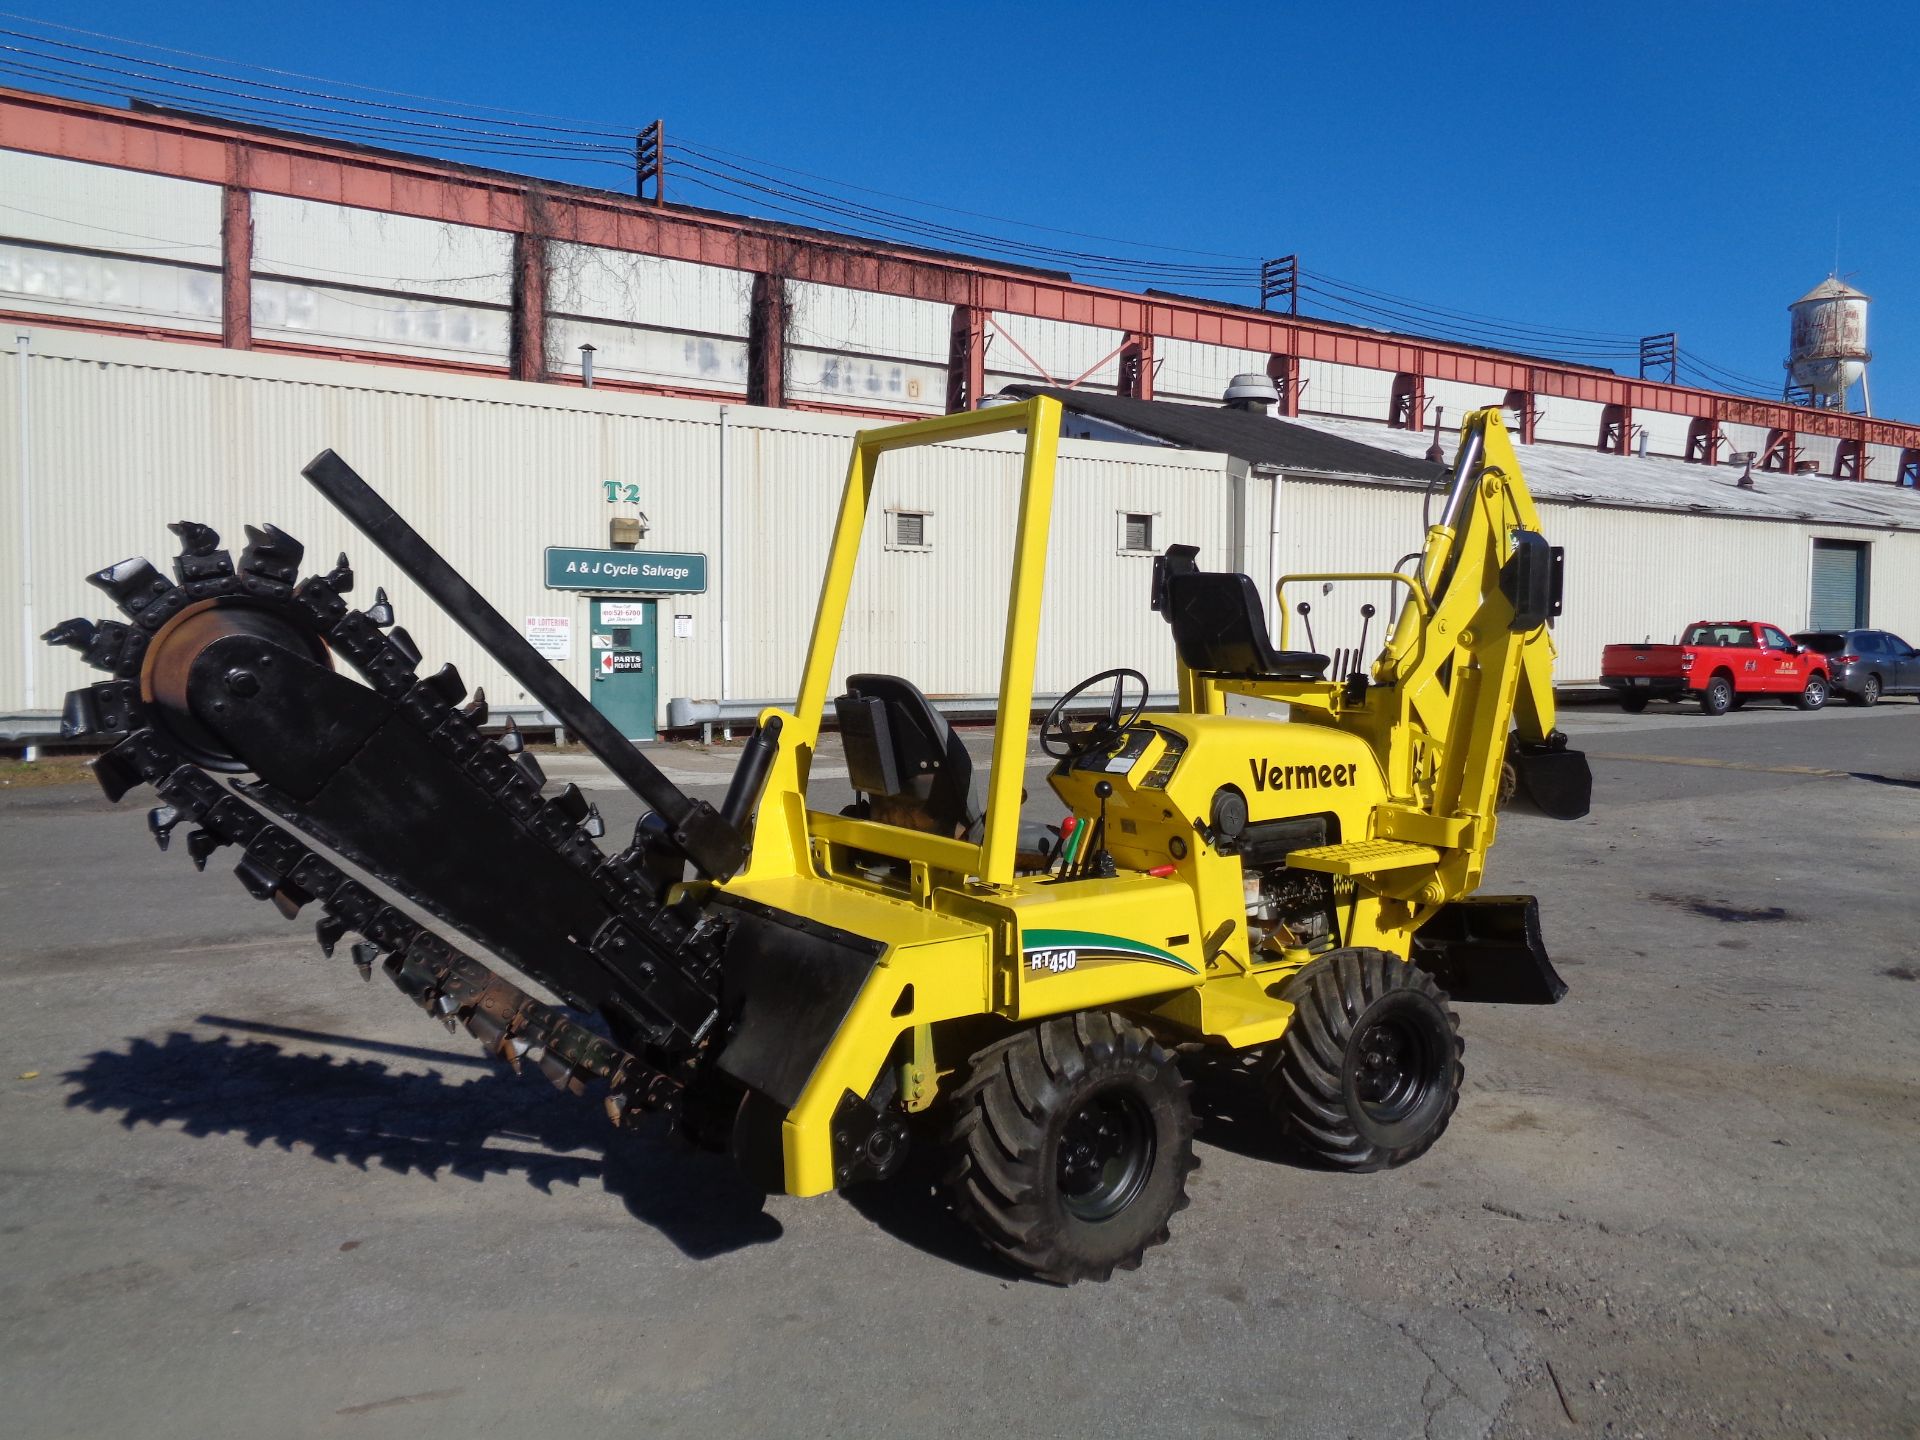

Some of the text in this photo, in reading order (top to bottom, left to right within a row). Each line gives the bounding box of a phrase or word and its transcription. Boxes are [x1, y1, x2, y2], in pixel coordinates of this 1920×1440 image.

[603, 480, 640, 502] T2
[566, 561, 689, 579] A & J Cycle Salvage
[527, 618, 569, 627] NO LOITERING
[1249, 758, 1357, 792] Vermeer
